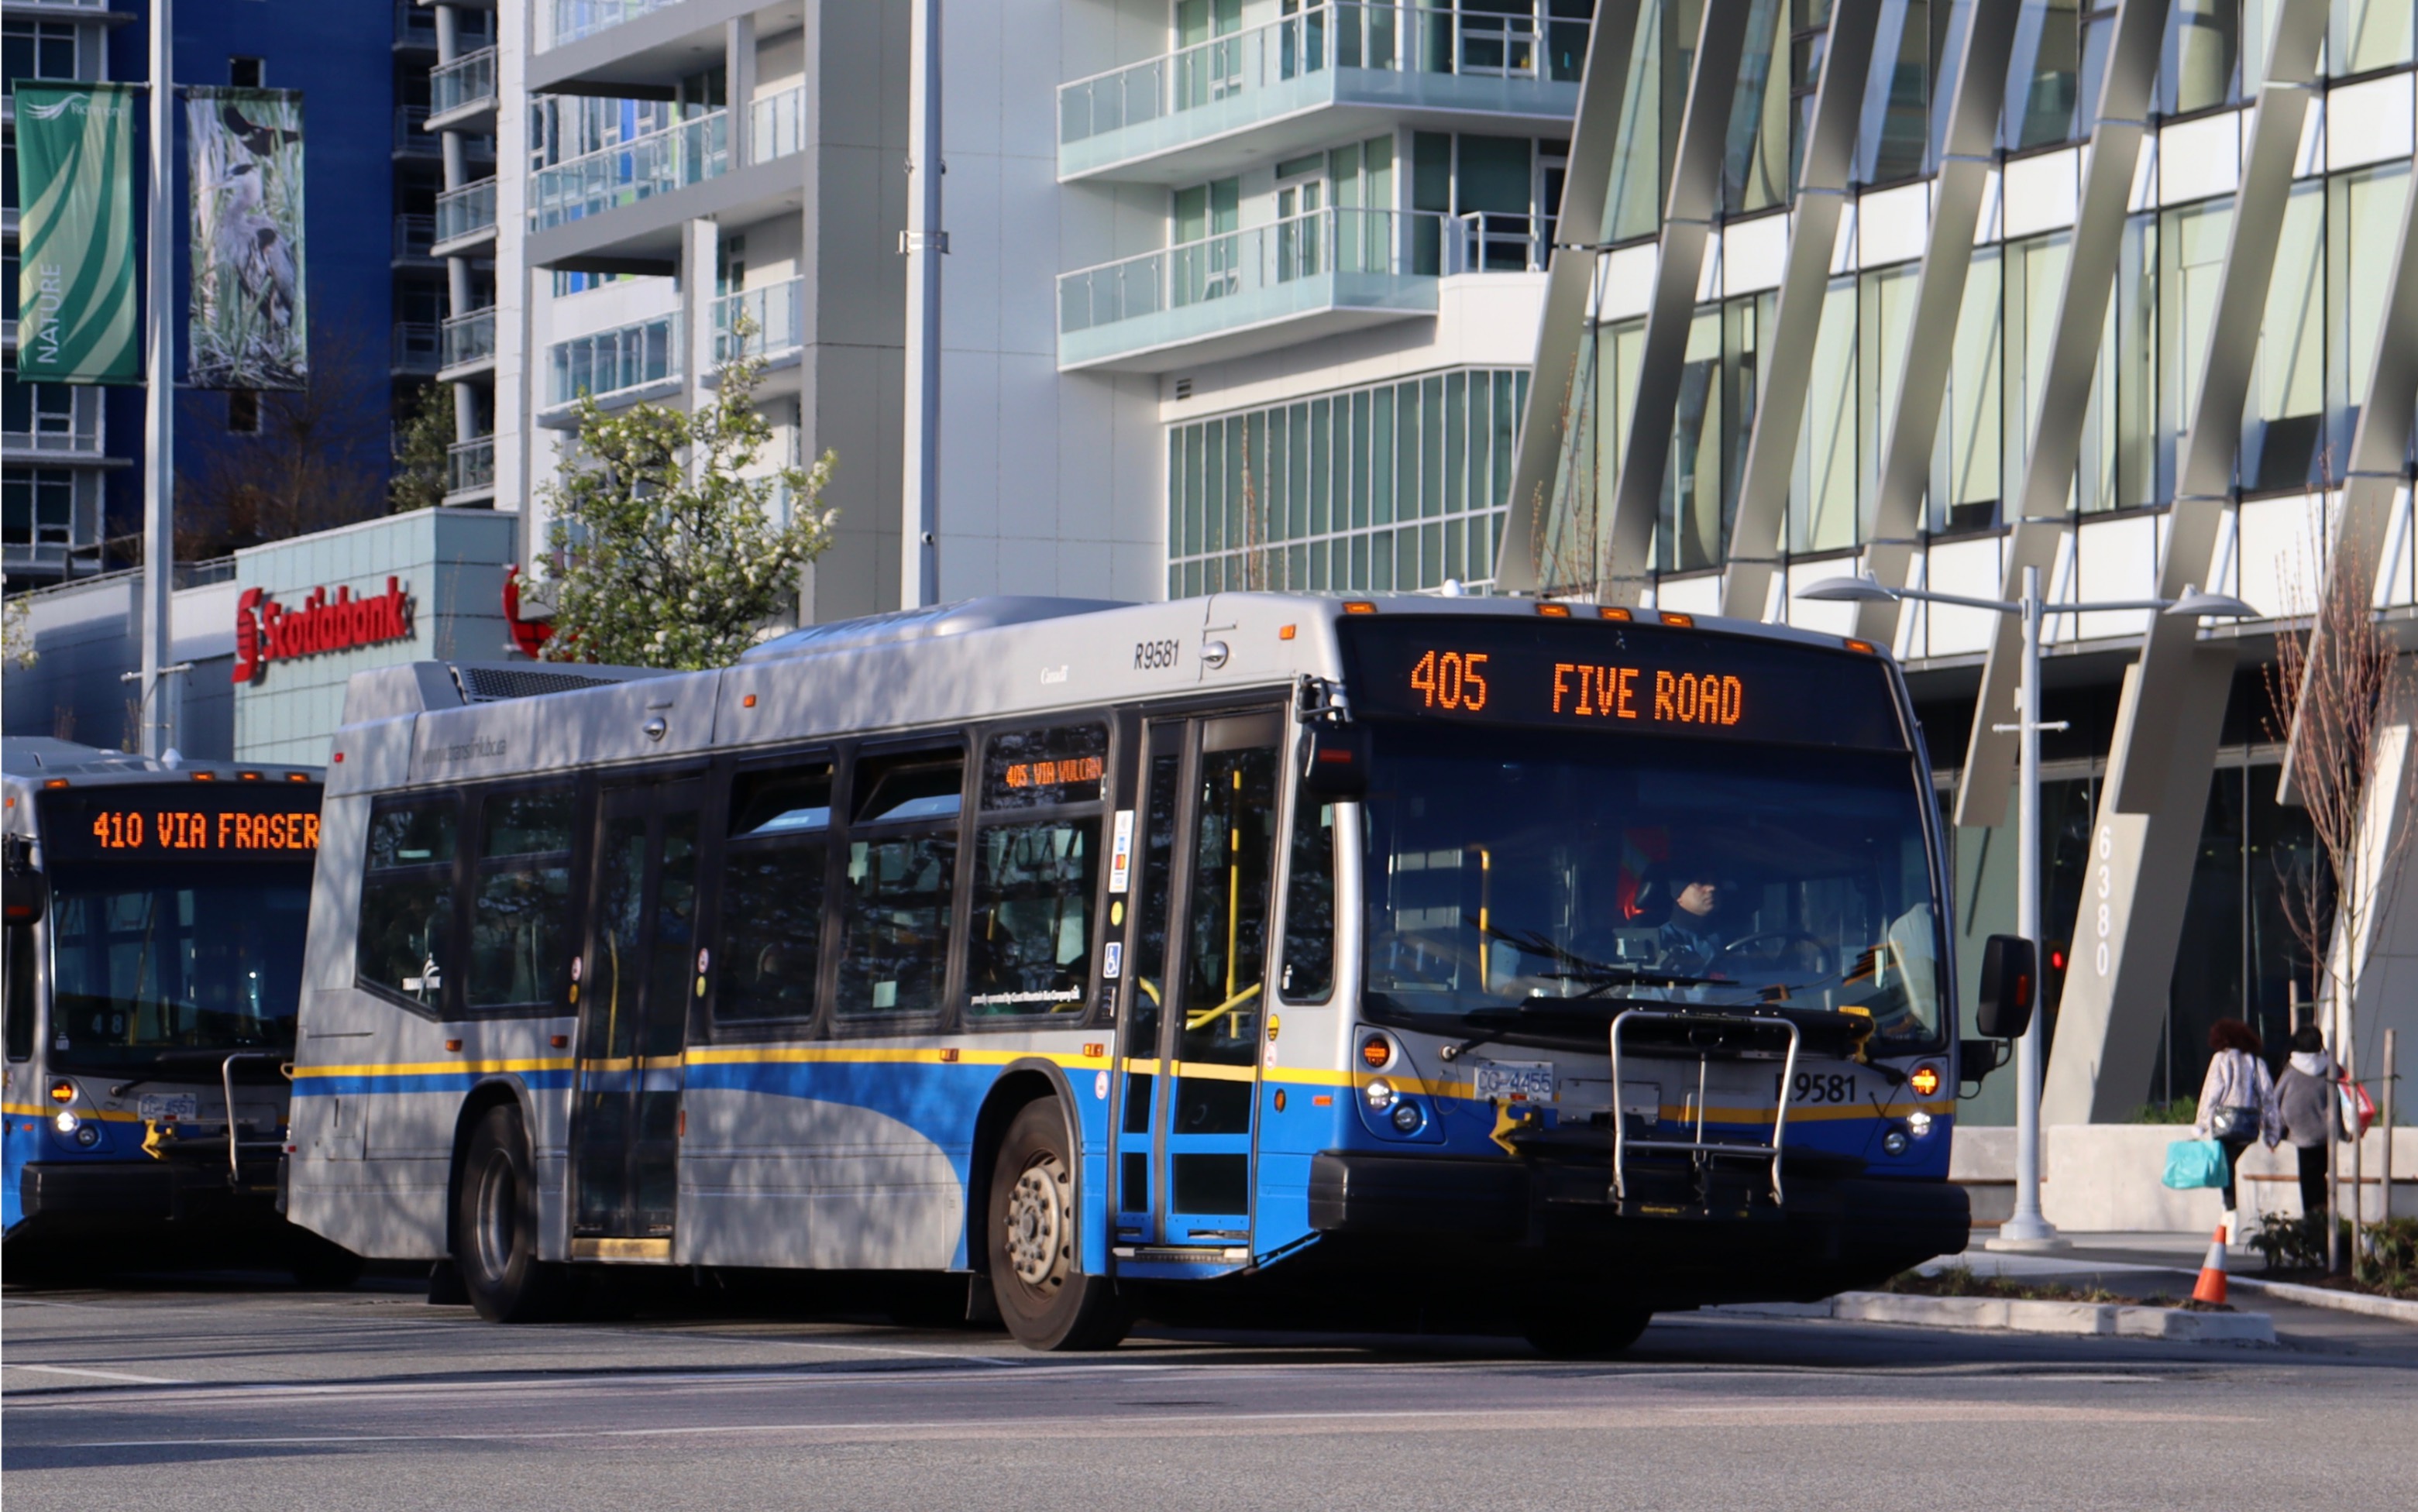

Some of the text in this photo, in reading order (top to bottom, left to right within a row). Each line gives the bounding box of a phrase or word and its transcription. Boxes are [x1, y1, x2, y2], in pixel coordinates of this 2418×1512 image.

[36, 263, 61, 363] NATURE
[263, 576, 408, 662] Scotiabank
[1133, 639, 1180, 671] R9581
[1412, 650, 1742, 725] 405 FIVE ROAD
[1006, 756, 1102, 788] 405 VIA VULCAN
[93, 812, 320, 849] 410 VIA FRASER
[2096, 825, 2111, 977] 6380
[1477, 1070, 1552, 1093] CG-4455
